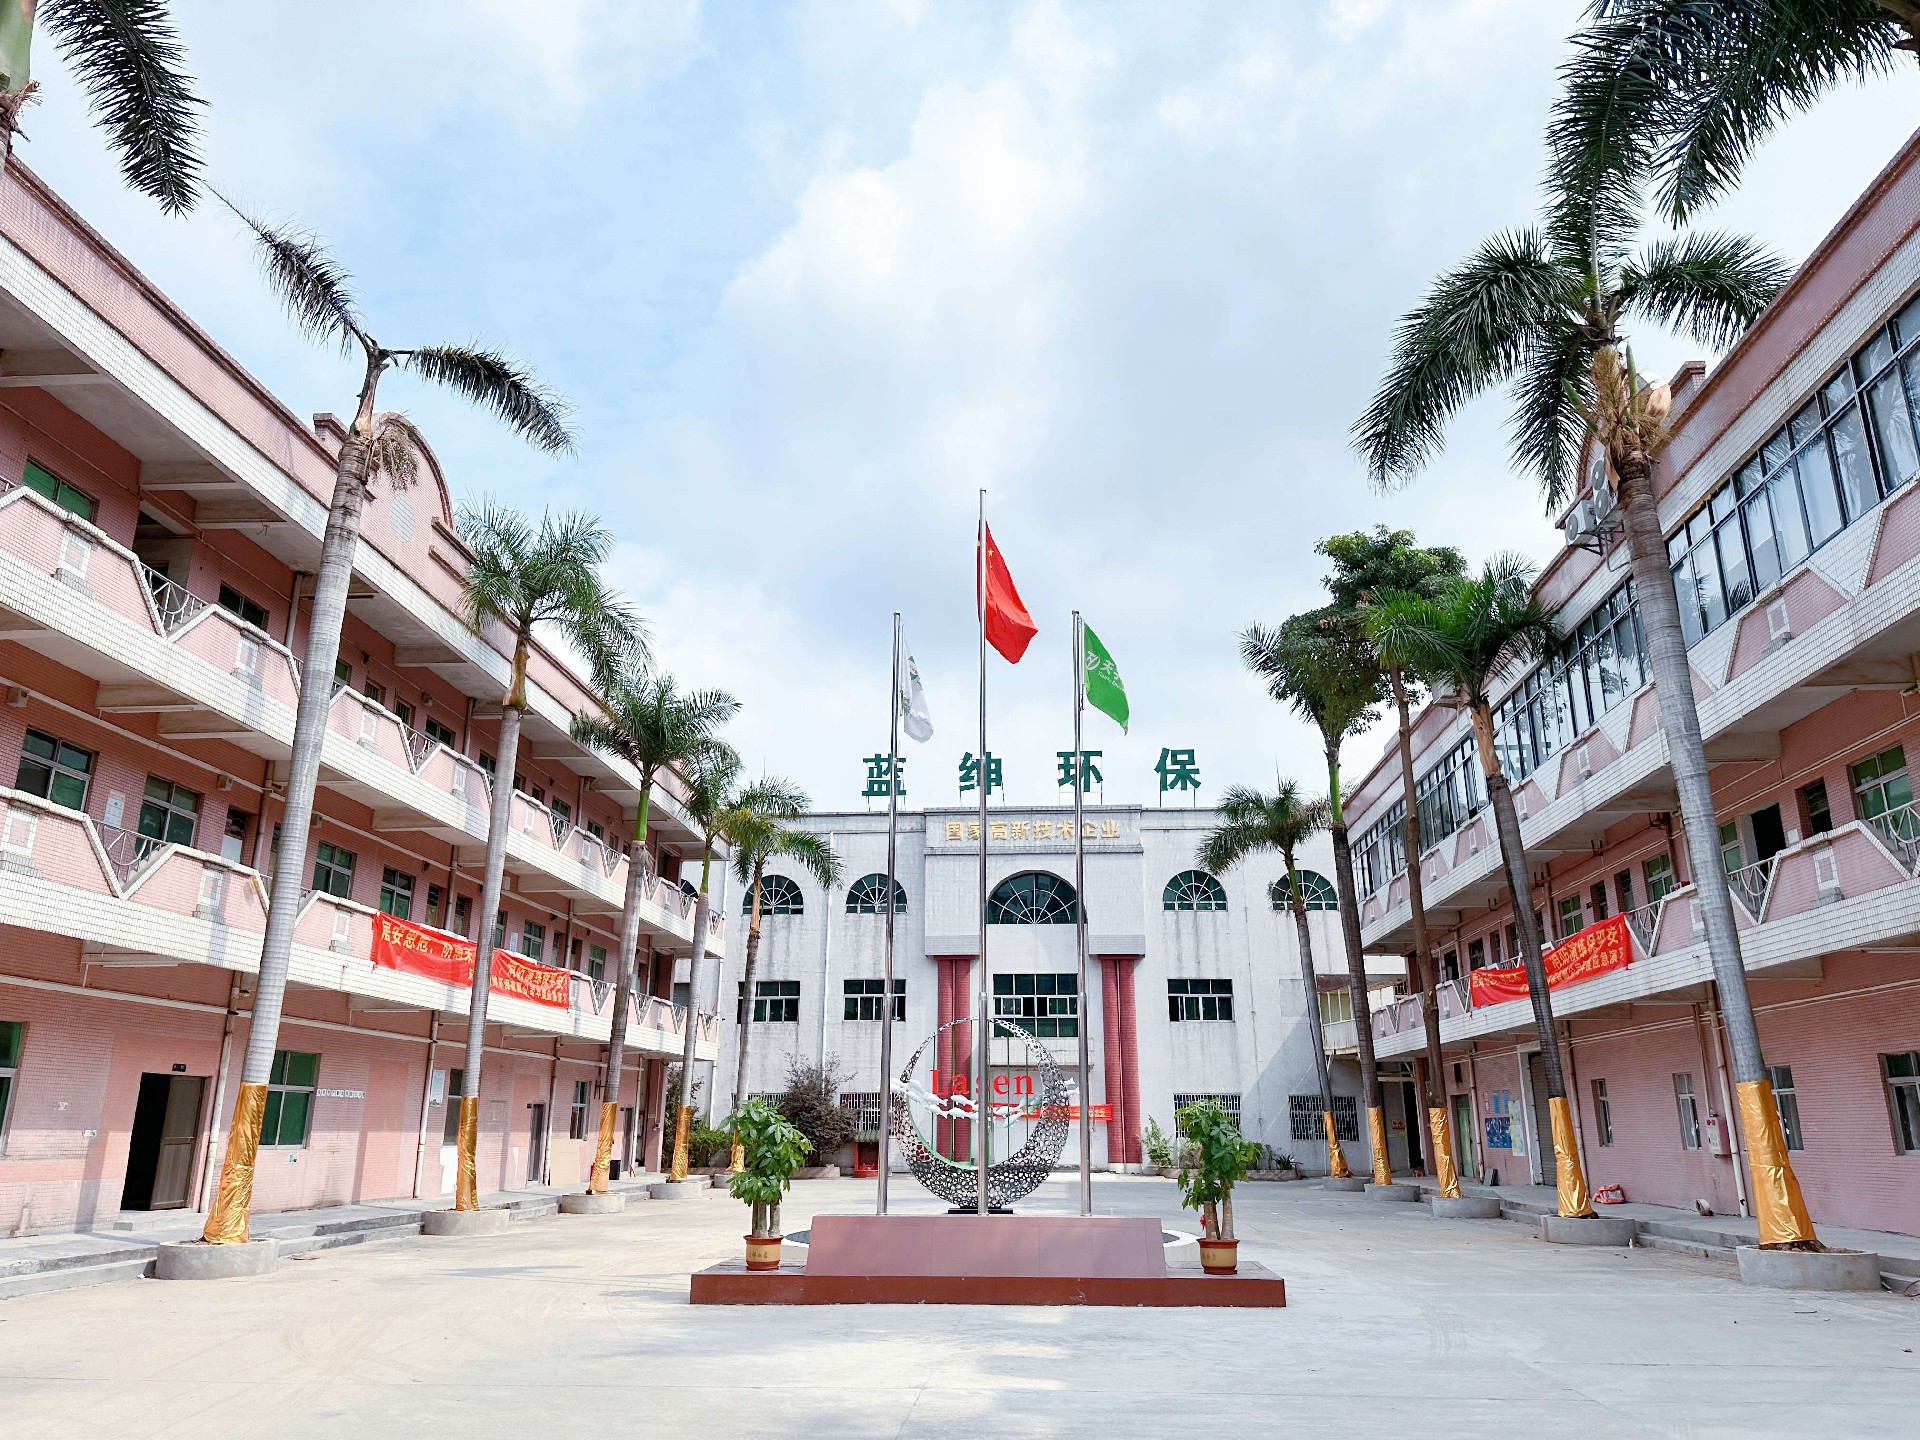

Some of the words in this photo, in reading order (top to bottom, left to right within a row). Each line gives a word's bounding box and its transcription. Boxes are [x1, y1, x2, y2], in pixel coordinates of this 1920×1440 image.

[861, 747, 1202, 796] 蓝绅环保
[945, 819, 1121, 841] 国家高新技术企业
